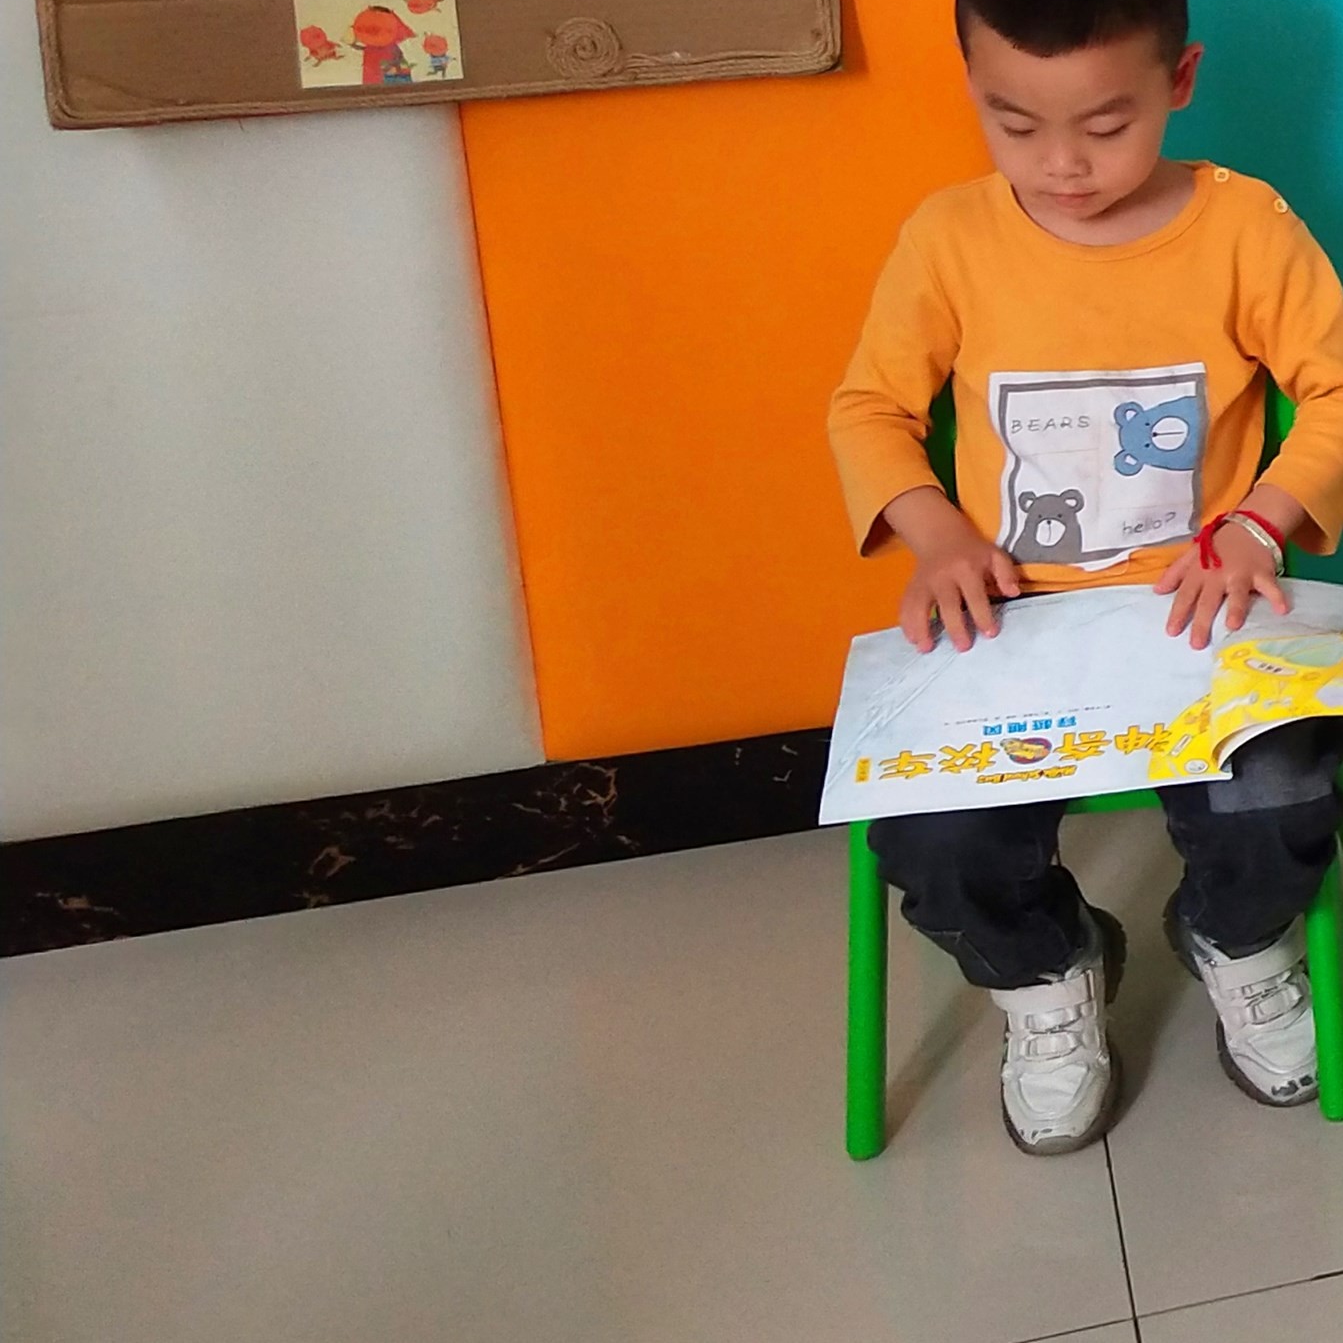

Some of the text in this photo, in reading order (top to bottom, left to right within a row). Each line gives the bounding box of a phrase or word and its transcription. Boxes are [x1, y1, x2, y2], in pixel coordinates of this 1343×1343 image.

[1010, 415, 1092, 434] BEARS
[878, 721, 1173, 782] 神奇校车
